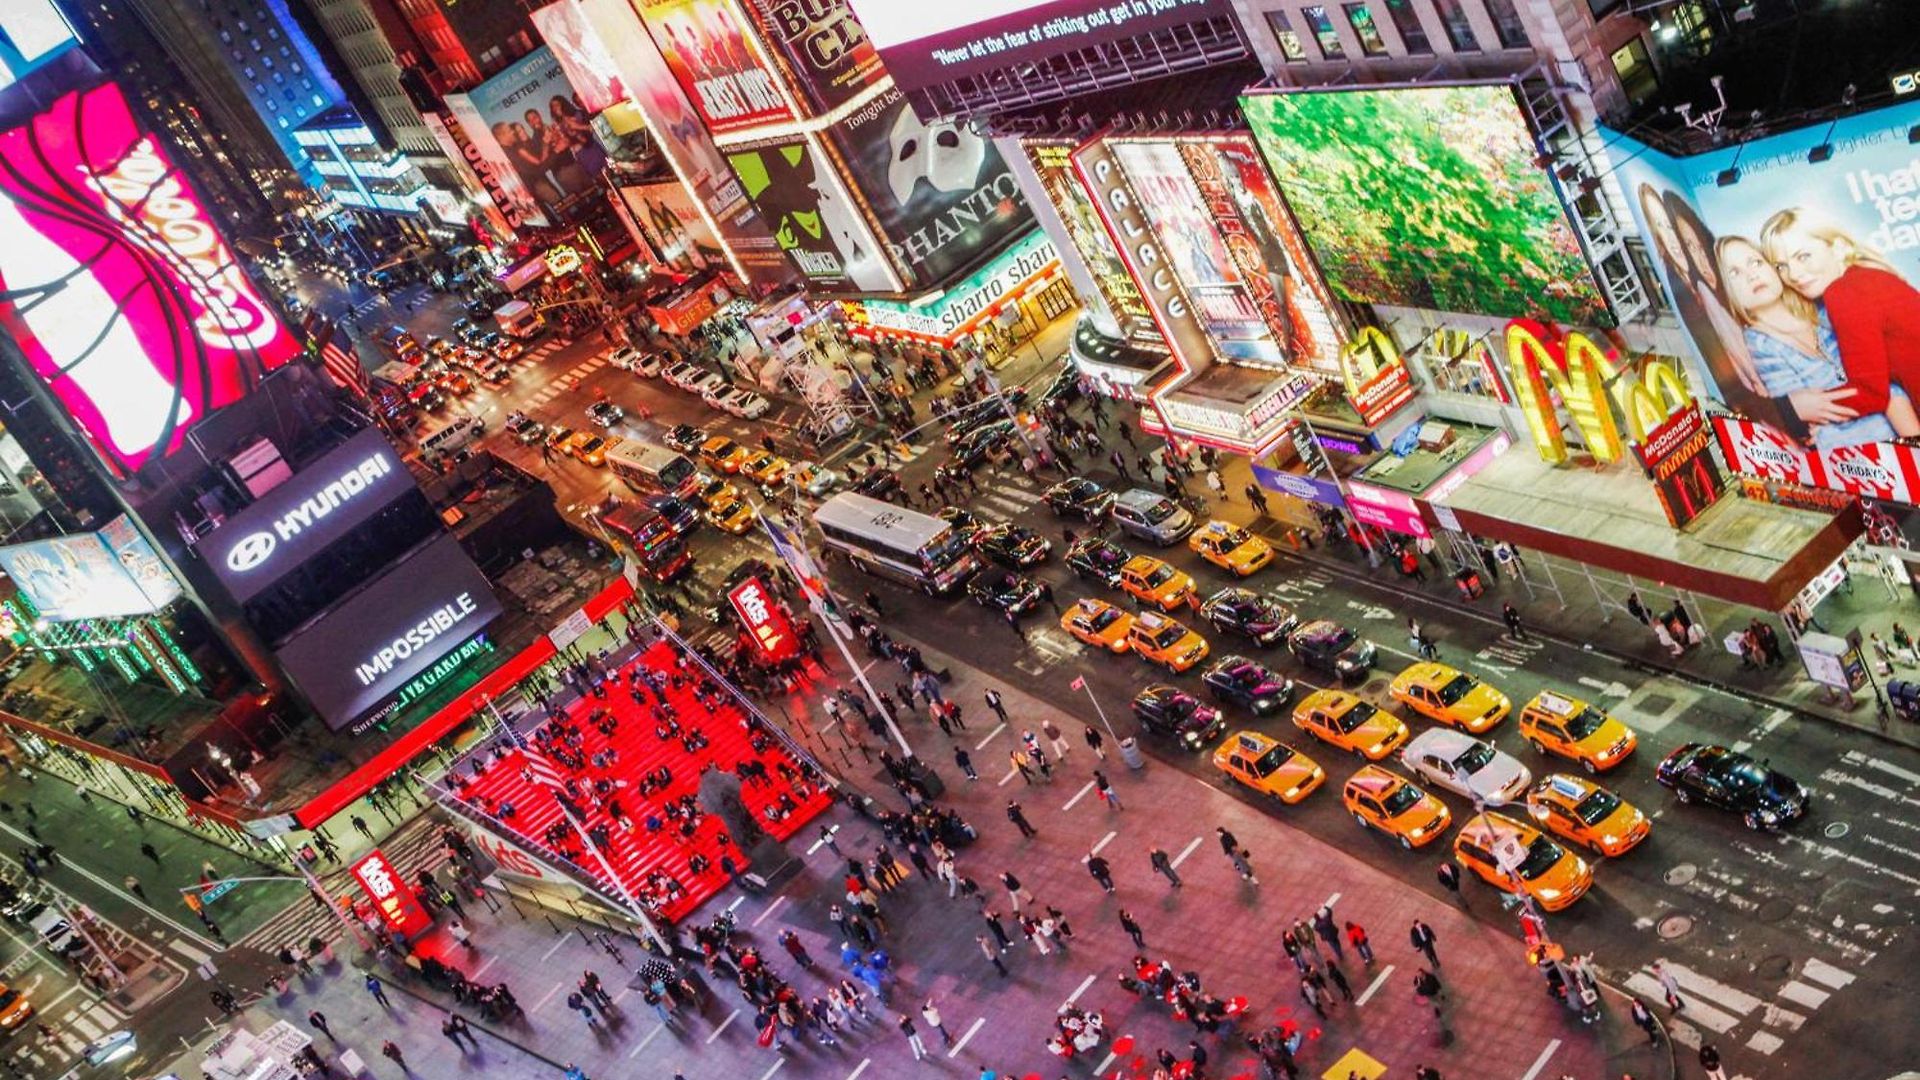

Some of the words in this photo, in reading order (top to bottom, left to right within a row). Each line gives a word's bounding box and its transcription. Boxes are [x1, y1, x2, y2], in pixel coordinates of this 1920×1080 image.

[970, 42, 986, 59] let
[987, 38, 1003, 54] the
[1004, 31, 1028, 51] fear
[1029, 24, 1042, 42] of
[1043, 15, 1088, 41] striking
[1089, 10, 1110, 28] out
[1111, 4, 1133, 25] get
[502, 79, 541, 110] BETTER
[844, 99, 887, 131] Tonight
[1095, 159, 1187, 318] PALACE
[675, 301, 713, 330] GIFTS
[942, 278, 1003, 333] sbarro
[273, 452, 392, 542] HYUNDAI
[739, 584, 771, 625] tkts
[354, 591, 478, 687] IMPOSSIBLE
[360, 856, 396, 898] tkts
